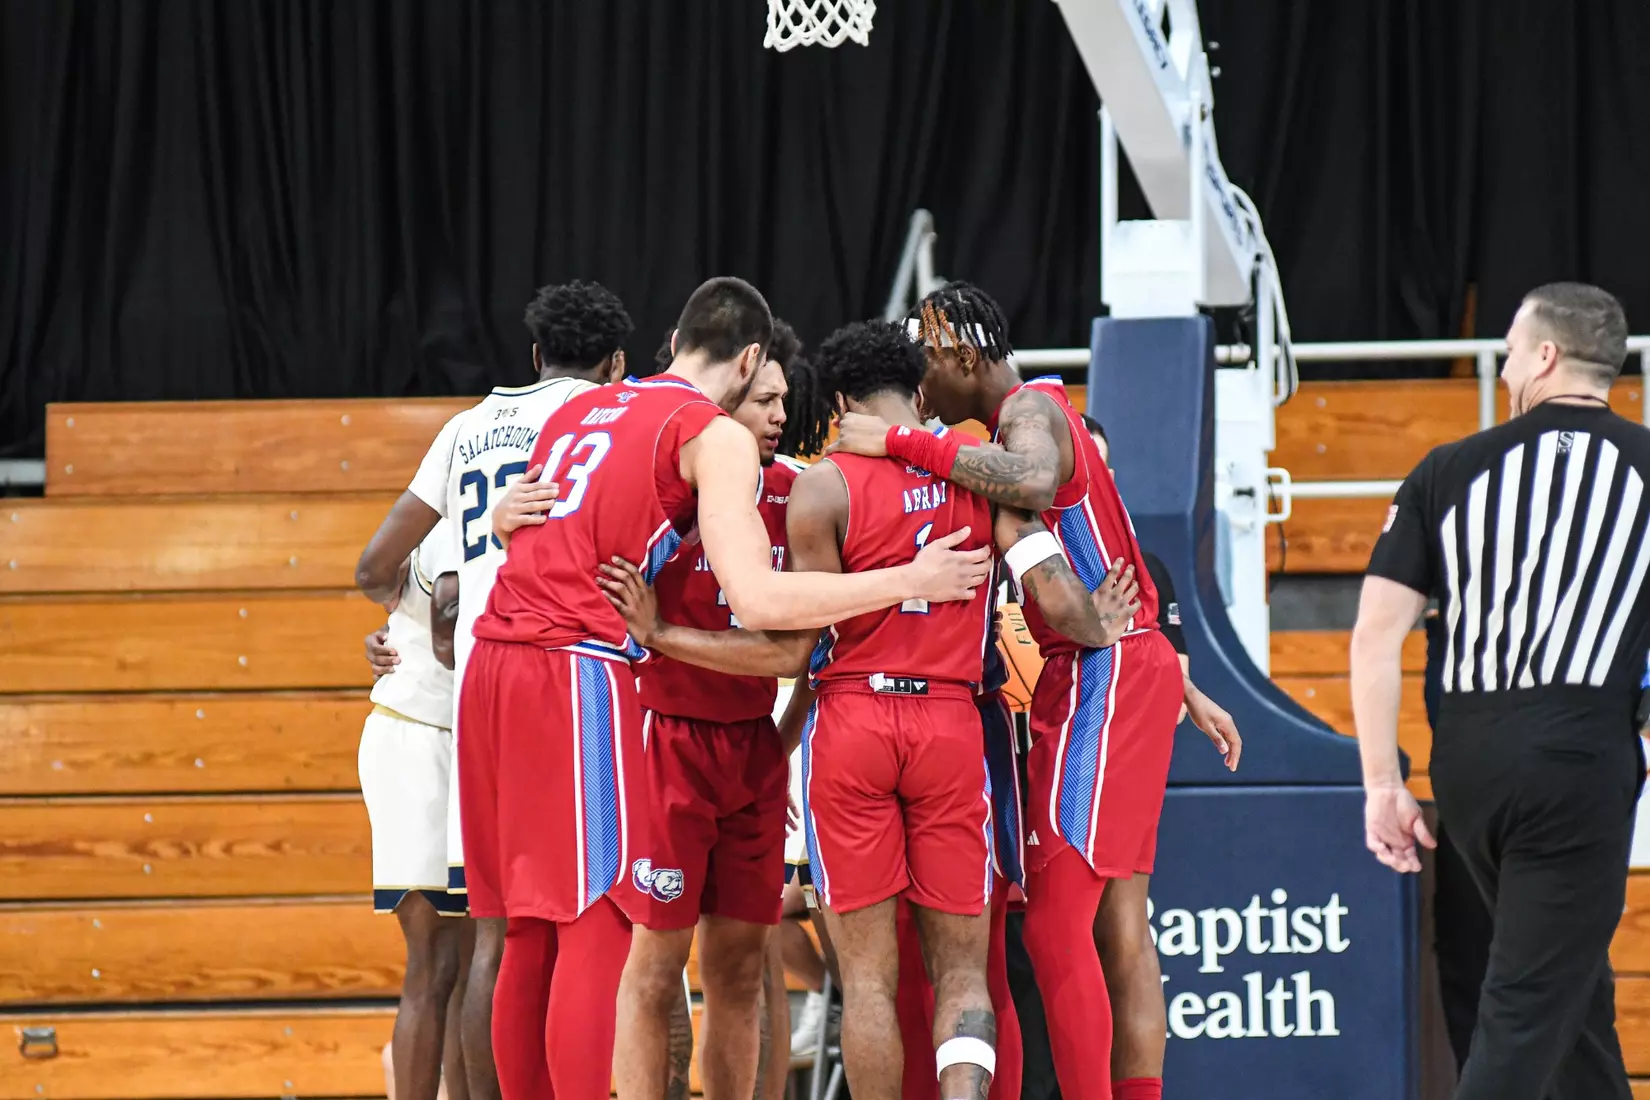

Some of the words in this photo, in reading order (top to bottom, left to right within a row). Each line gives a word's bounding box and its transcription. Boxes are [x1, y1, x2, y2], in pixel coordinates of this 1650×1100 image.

[539, 431, 613, 519] 13
[1145, 888, 1351, 973] aptist
[1162, 970, 1340, 1040] ealth
